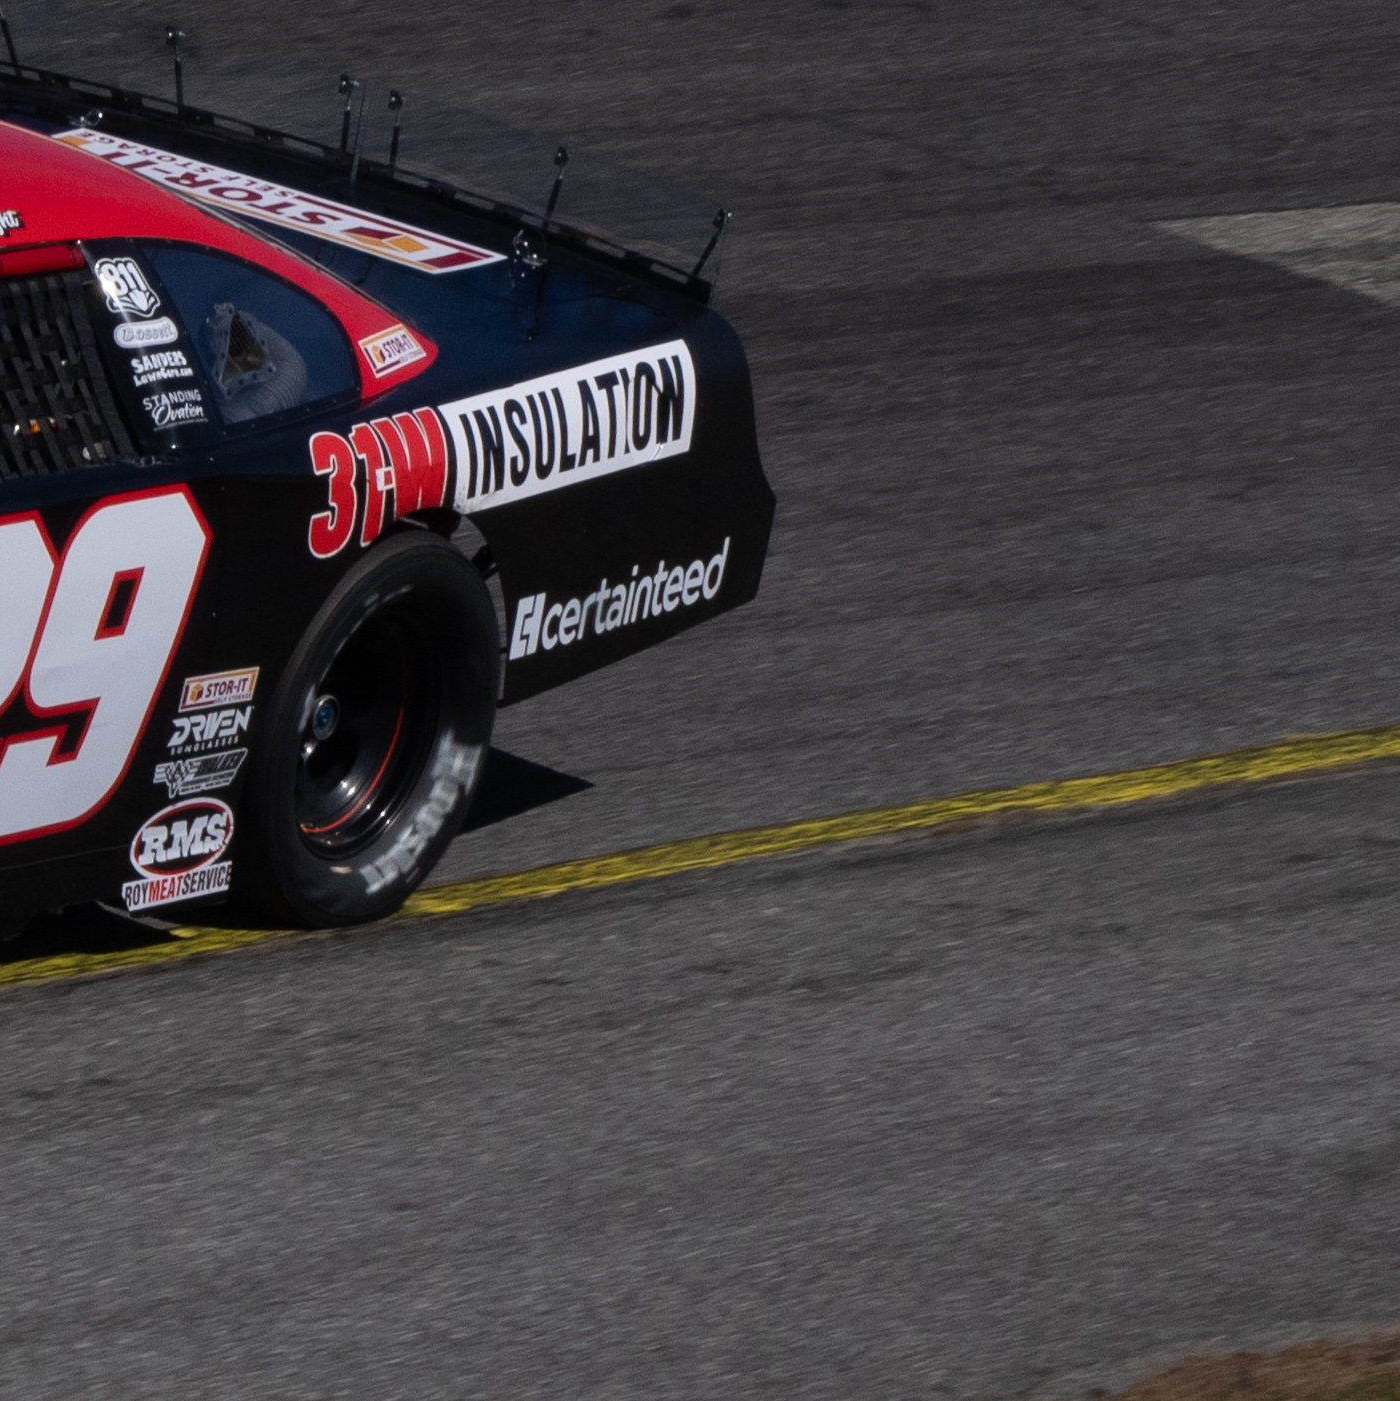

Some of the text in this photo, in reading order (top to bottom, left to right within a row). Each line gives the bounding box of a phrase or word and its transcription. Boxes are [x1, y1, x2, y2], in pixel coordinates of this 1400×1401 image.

[78, 131, 295, 198] SELF STORAGE
[101, 151, 343, 226] STOR-IT
[98, 261, 148, 297] 811
[130, 350, 188, 374] SANDERS
[308, 354, 686, 559] 31-W INSULATION
[541, 536, 731, 652] certainteed
[205, 677, 250, 699] STOR-IT
[166, 705, 253, 748] DRIVEN
[169, 736, 239, 756] SUNGLASSES
[138, 811, 228, 867] RMS
